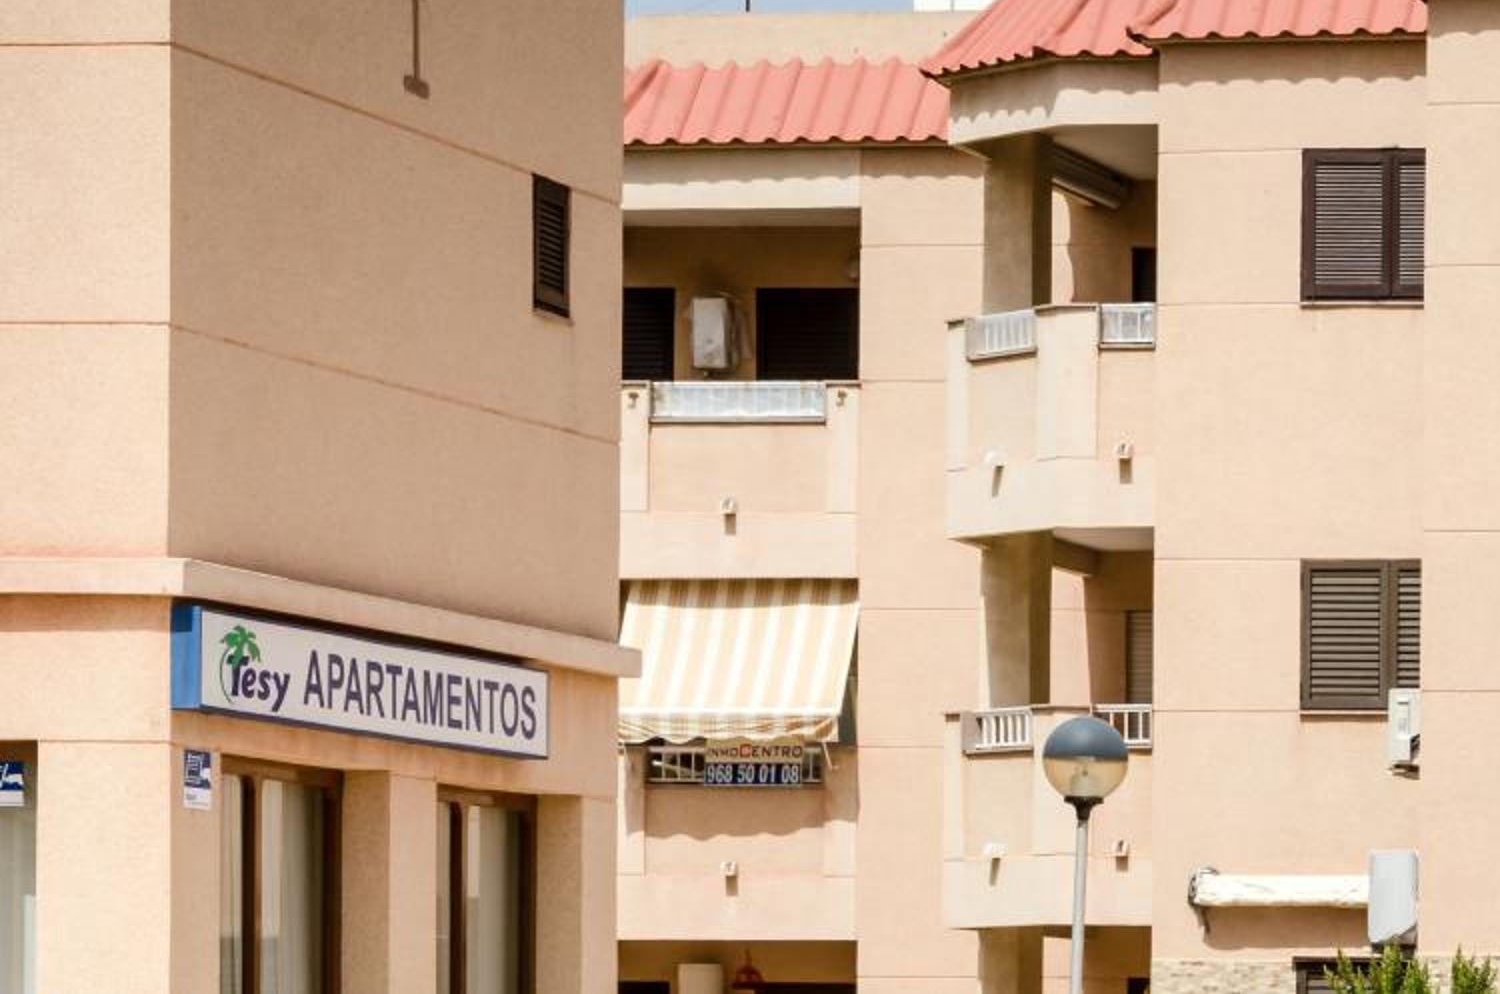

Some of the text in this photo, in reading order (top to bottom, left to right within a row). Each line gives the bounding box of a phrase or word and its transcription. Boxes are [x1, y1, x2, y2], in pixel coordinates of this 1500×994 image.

[227, 649, 537, 740] Tesy APARTAMENTOS
[707, 764, 799, 783] 968 50 01 08
